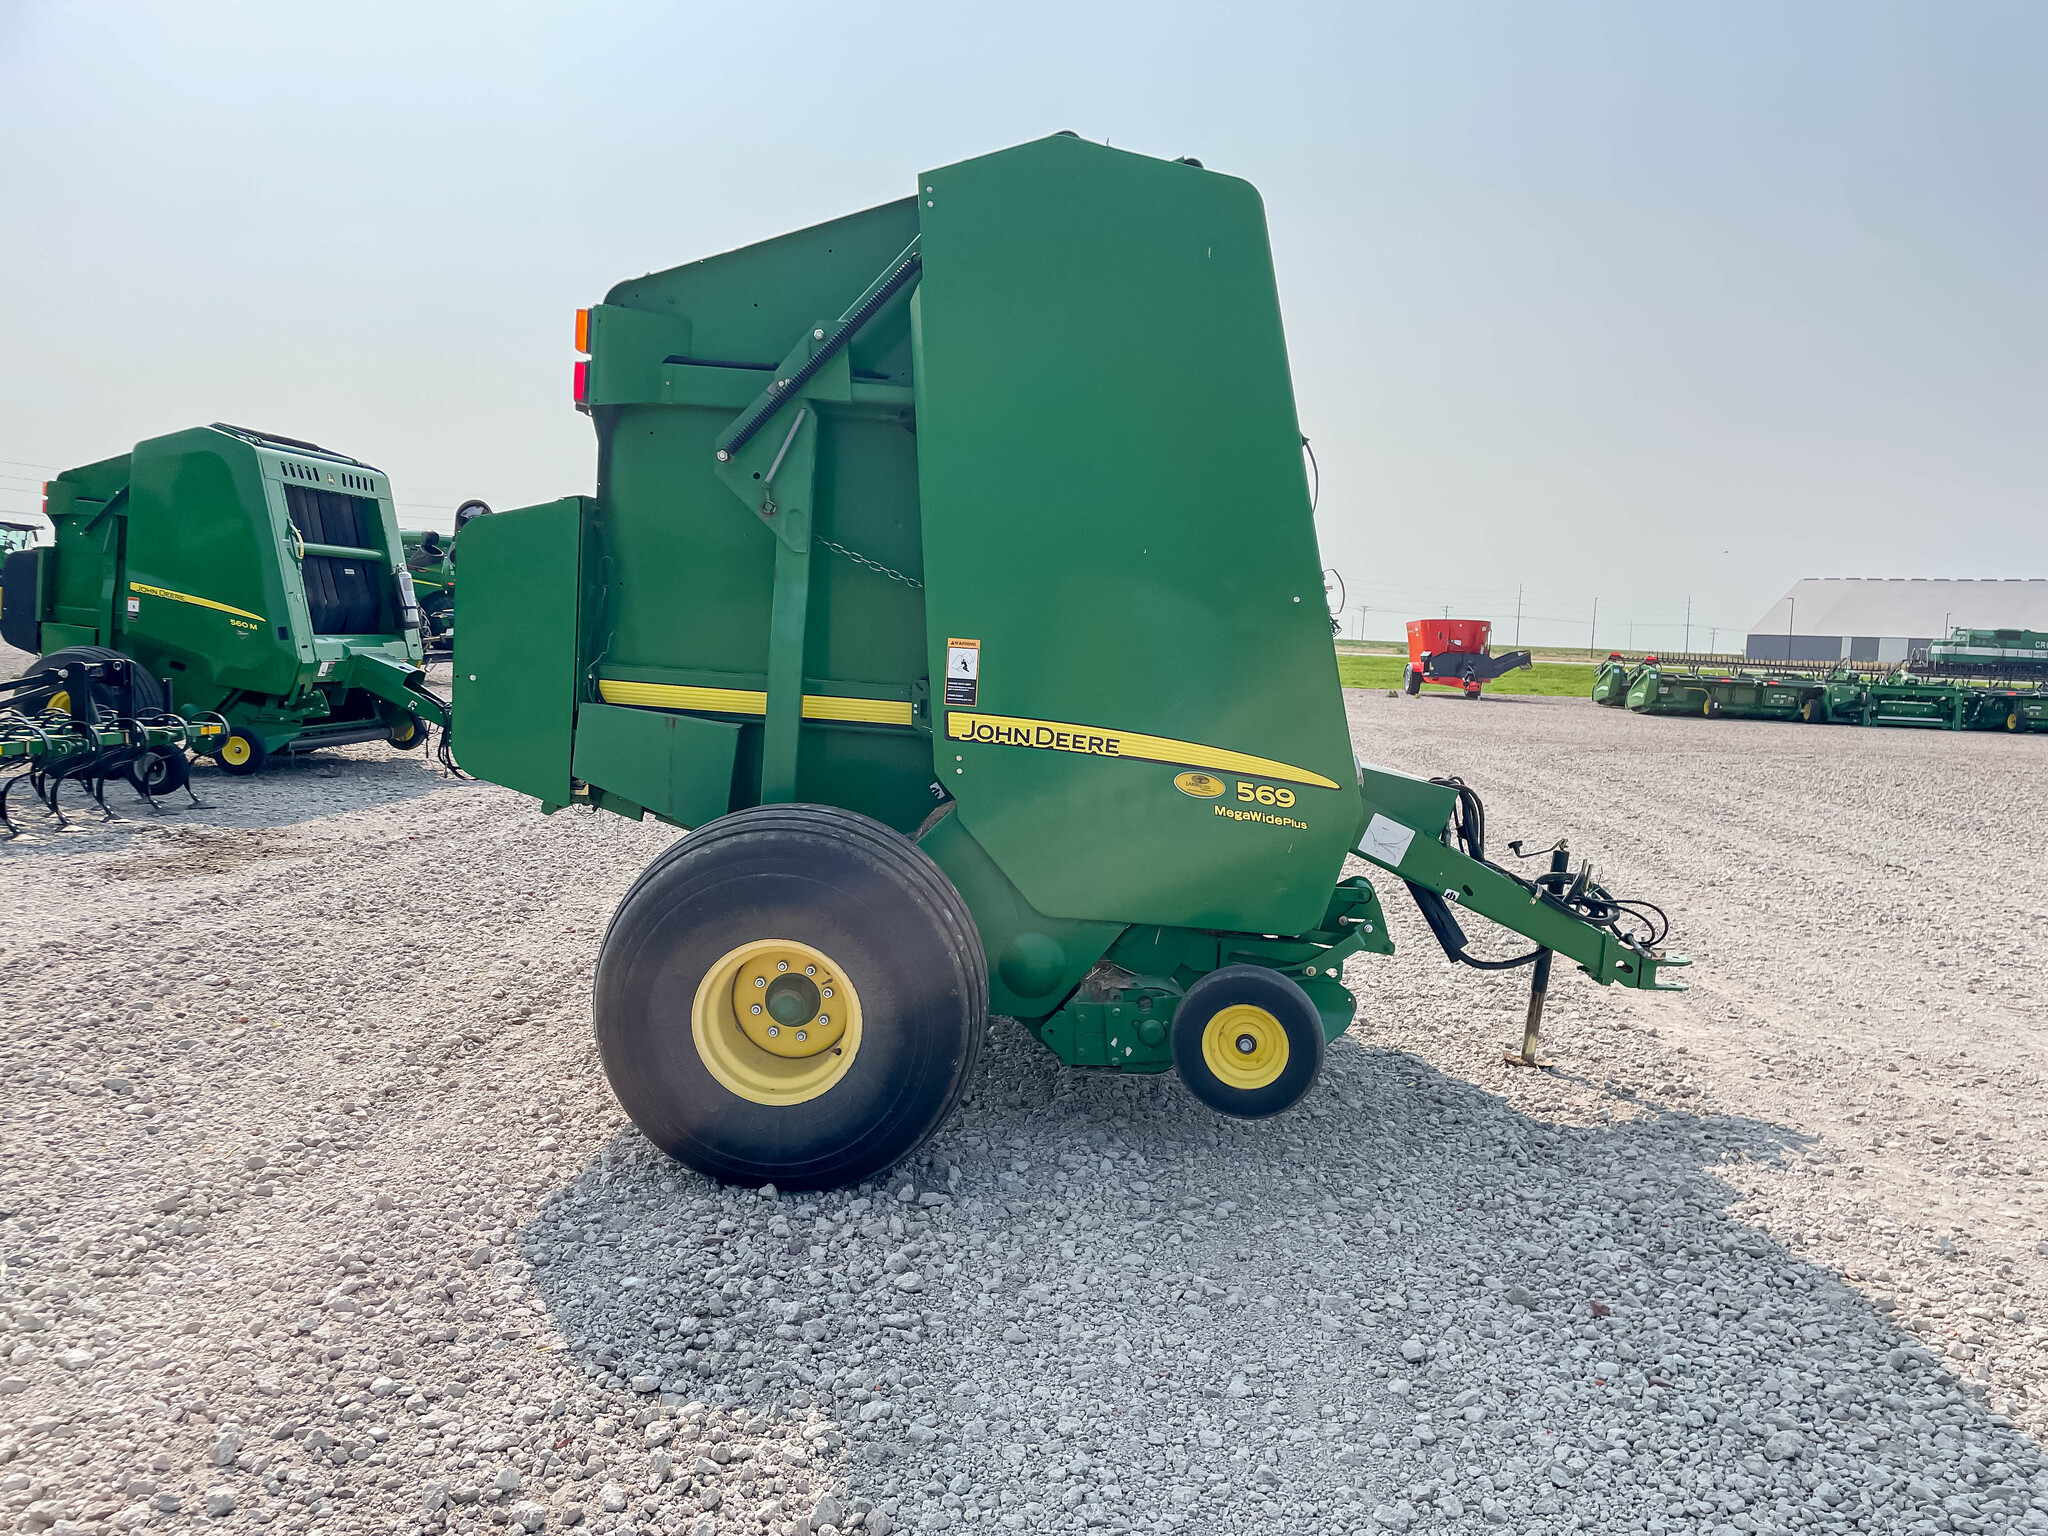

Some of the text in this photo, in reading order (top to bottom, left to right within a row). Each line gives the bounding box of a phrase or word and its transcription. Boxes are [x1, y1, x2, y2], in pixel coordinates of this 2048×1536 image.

[136, 585, 185, 601] JOHN DEERE
[230, 618, 258, 631] 560 M
[962, 720, 1120, 755] JOHN DEERE
[1236, 781, 1296, 808] 569
[1214, 804, 1308, 830] MegaWidePlus
